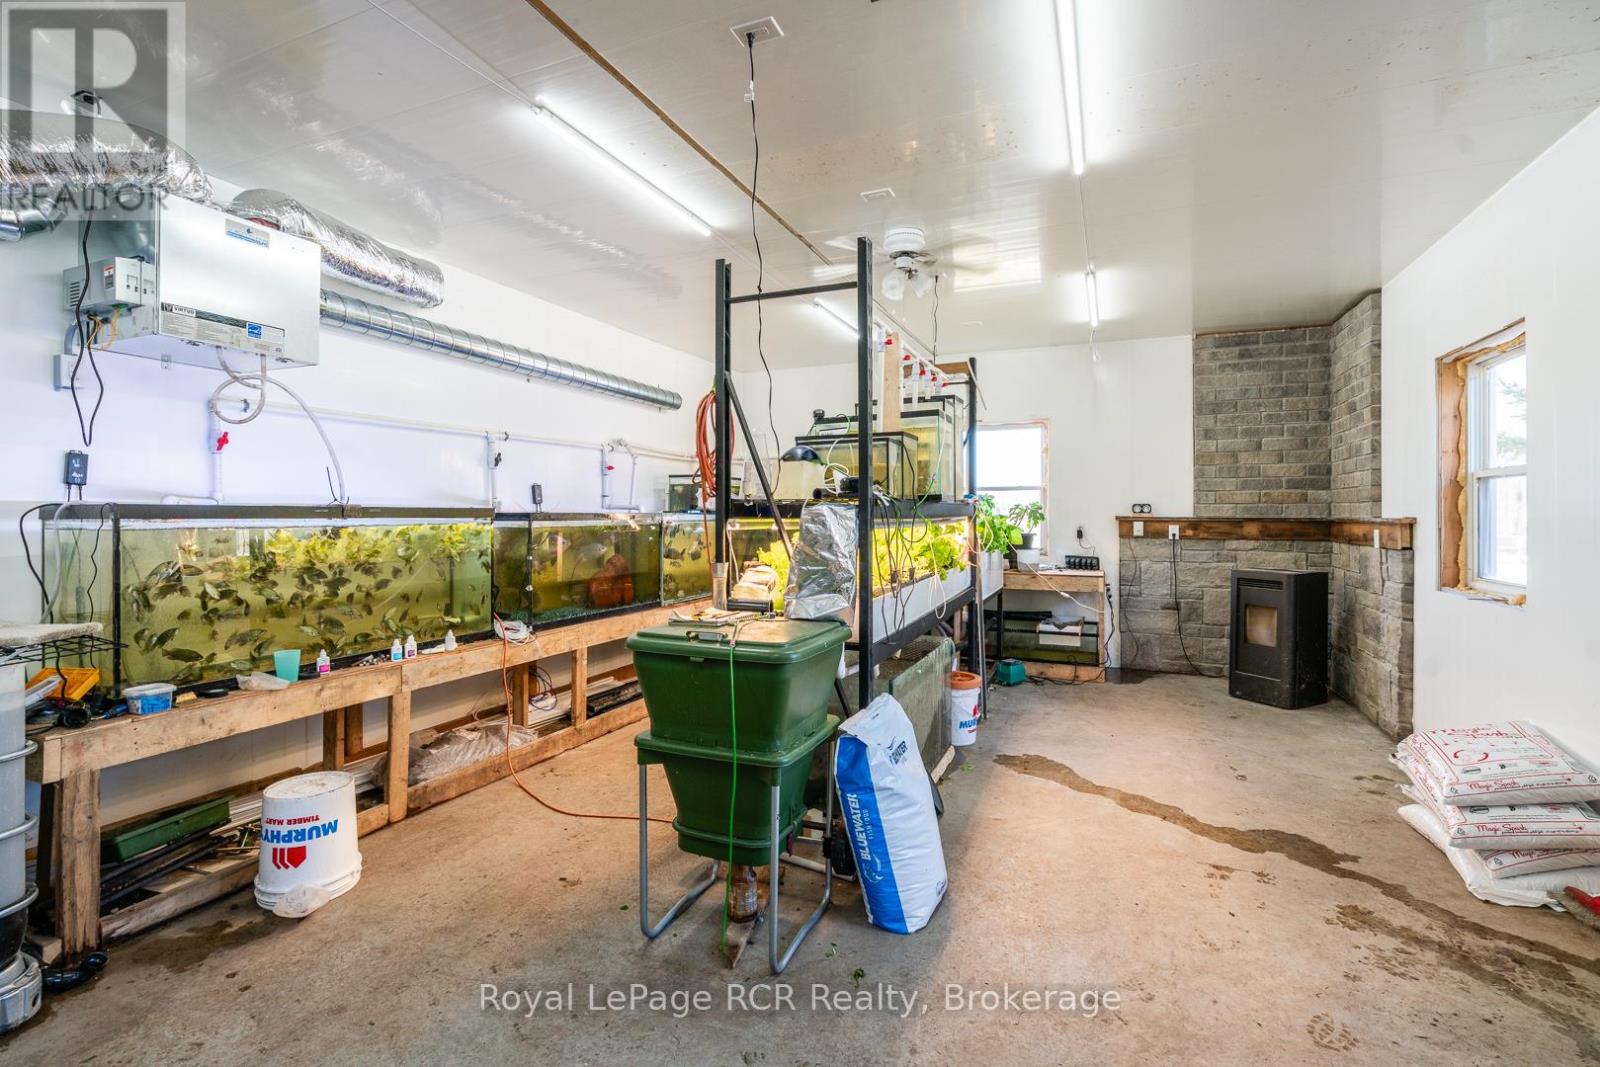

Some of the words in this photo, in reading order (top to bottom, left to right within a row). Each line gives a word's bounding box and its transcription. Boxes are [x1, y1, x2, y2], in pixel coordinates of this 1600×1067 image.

[265, 817, 284, 825] MART
[287, 814, 320, 826] TIMBER
[847, 793, 871, 860] BLUEWATER
